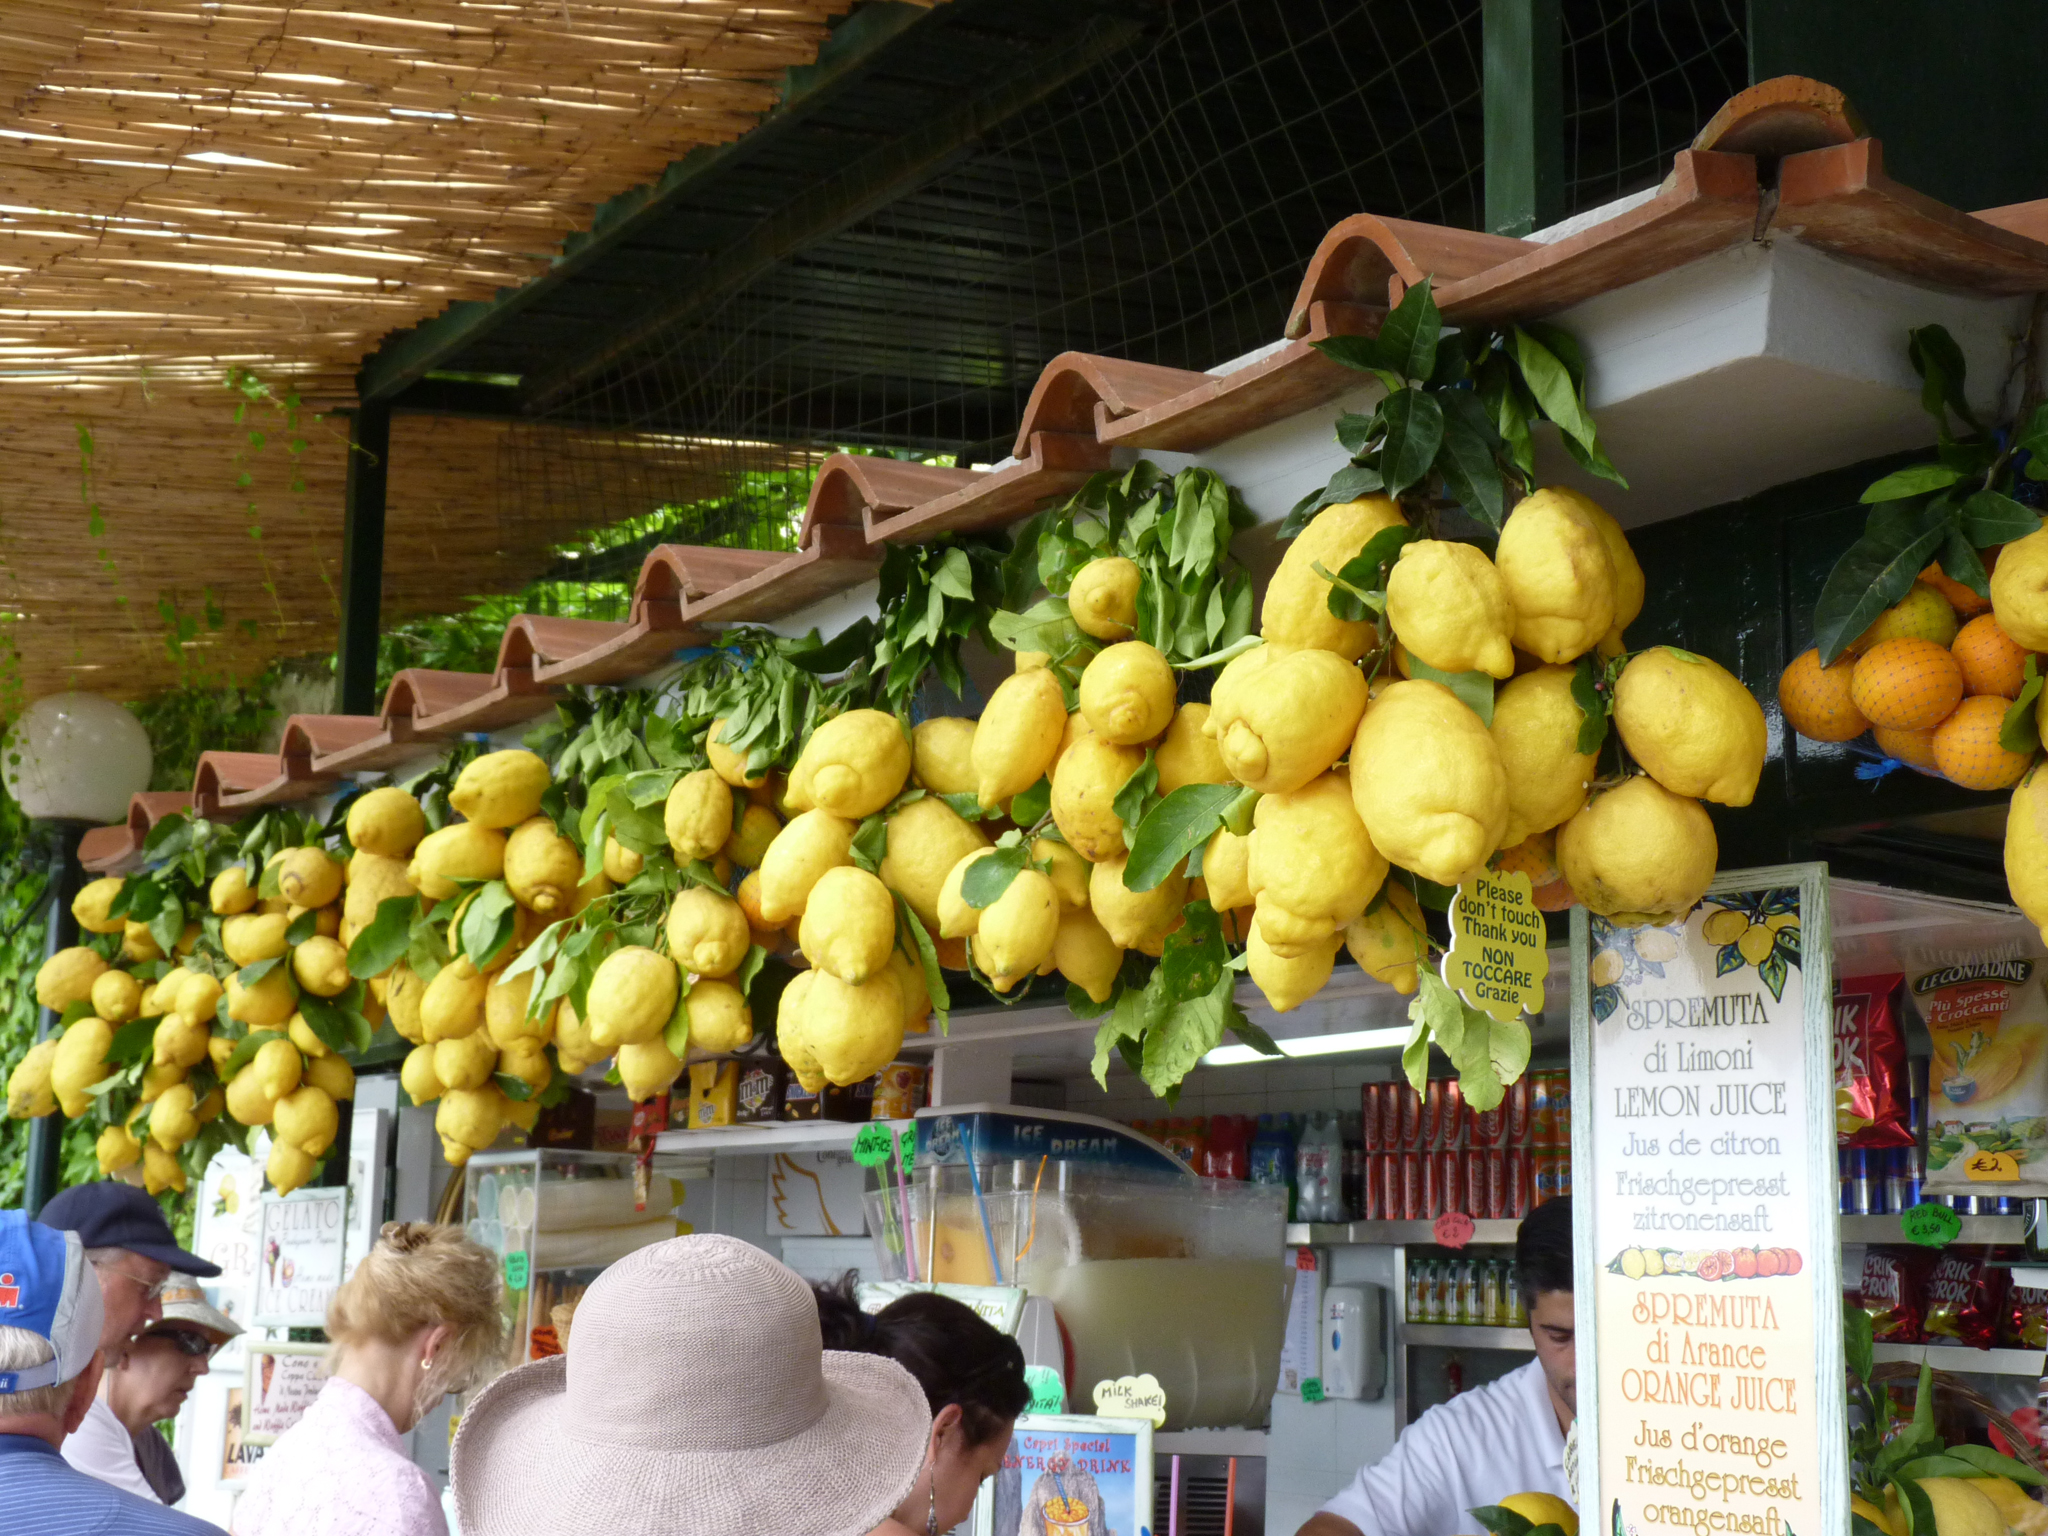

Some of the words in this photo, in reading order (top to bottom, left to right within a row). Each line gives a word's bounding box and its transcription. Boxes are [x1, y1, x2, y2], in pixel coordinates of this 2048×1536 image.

[1476, 879, 1523, 905] Please
[1459, 895, 1497, 919] don't
[1501, 906, 1540, 929] touch
[1462, 916, 1508, 942] Thank
[1511, 929, 1537, 948] you
[1482, 946, 1514, 967] NON
[1462, 961, 1533, 989] TOCCARE
[1475, 982, 1520, 1004] Grazie
[1930, 1000, 1952, 1012] Più
[1626, 992, 1770, 1031] SPREMUTA
[1833, 1005, 1860, 1036] IK
[1938, 1000, 2010, 1023] Croccanti
[1644, 1040, 1667, 1073] di
[1677, 1040, 1754, 1073] Limoni
[1614, 1085, 1701, 1119] LEMON
[1710, 1082, 1787, 1116] JUICE
[901, 1130, 915, 1147] GR
[1013, 1125, 1045, 1142] ICE
[1050, 1138, 1118, 1154] DREAM
[1622, 1132, 1661, 1157] Jus
[1668, 1129, 1701, 1156] de
[1710, 1130, 1782, 1155] citron
[1615, 1169, 1791, 1206] Frischgepresst
[267, 1200, 340, 1232] GELATO
[1633, 1204, 1773, 1232] zitronensaft
[1909, 1208, 1929, 1223] RED
[1932, 1208, 1955, 1225] BULL
[210, 1242, 253, 1279] GR
[1632, 1291, 1780, 1330] SPREMUTA
[1646, 1327, 1670, 1364] di
[1681, 1331, 1767, 1369] Arance
[1621, 1368, 1721, 1409] ORANGE
[1731, 1375, 1798, 1415] JUICE
[1024, 1436, 1059, 1453] Capri
[1064, 1436, 1111, 1454] Special
[1634, 1420, 1673, 1448] Jus
[1681, 1422, 1788, 1468] d'orange
[1003, 1455, 1070, 1474] ENERGY
[1077, 1457, 1133, 1475] DRINK
[1625, 1456, 1803, 1501] Frischgepresst
[1643, 1504, 1785, 1536] orangensaft
